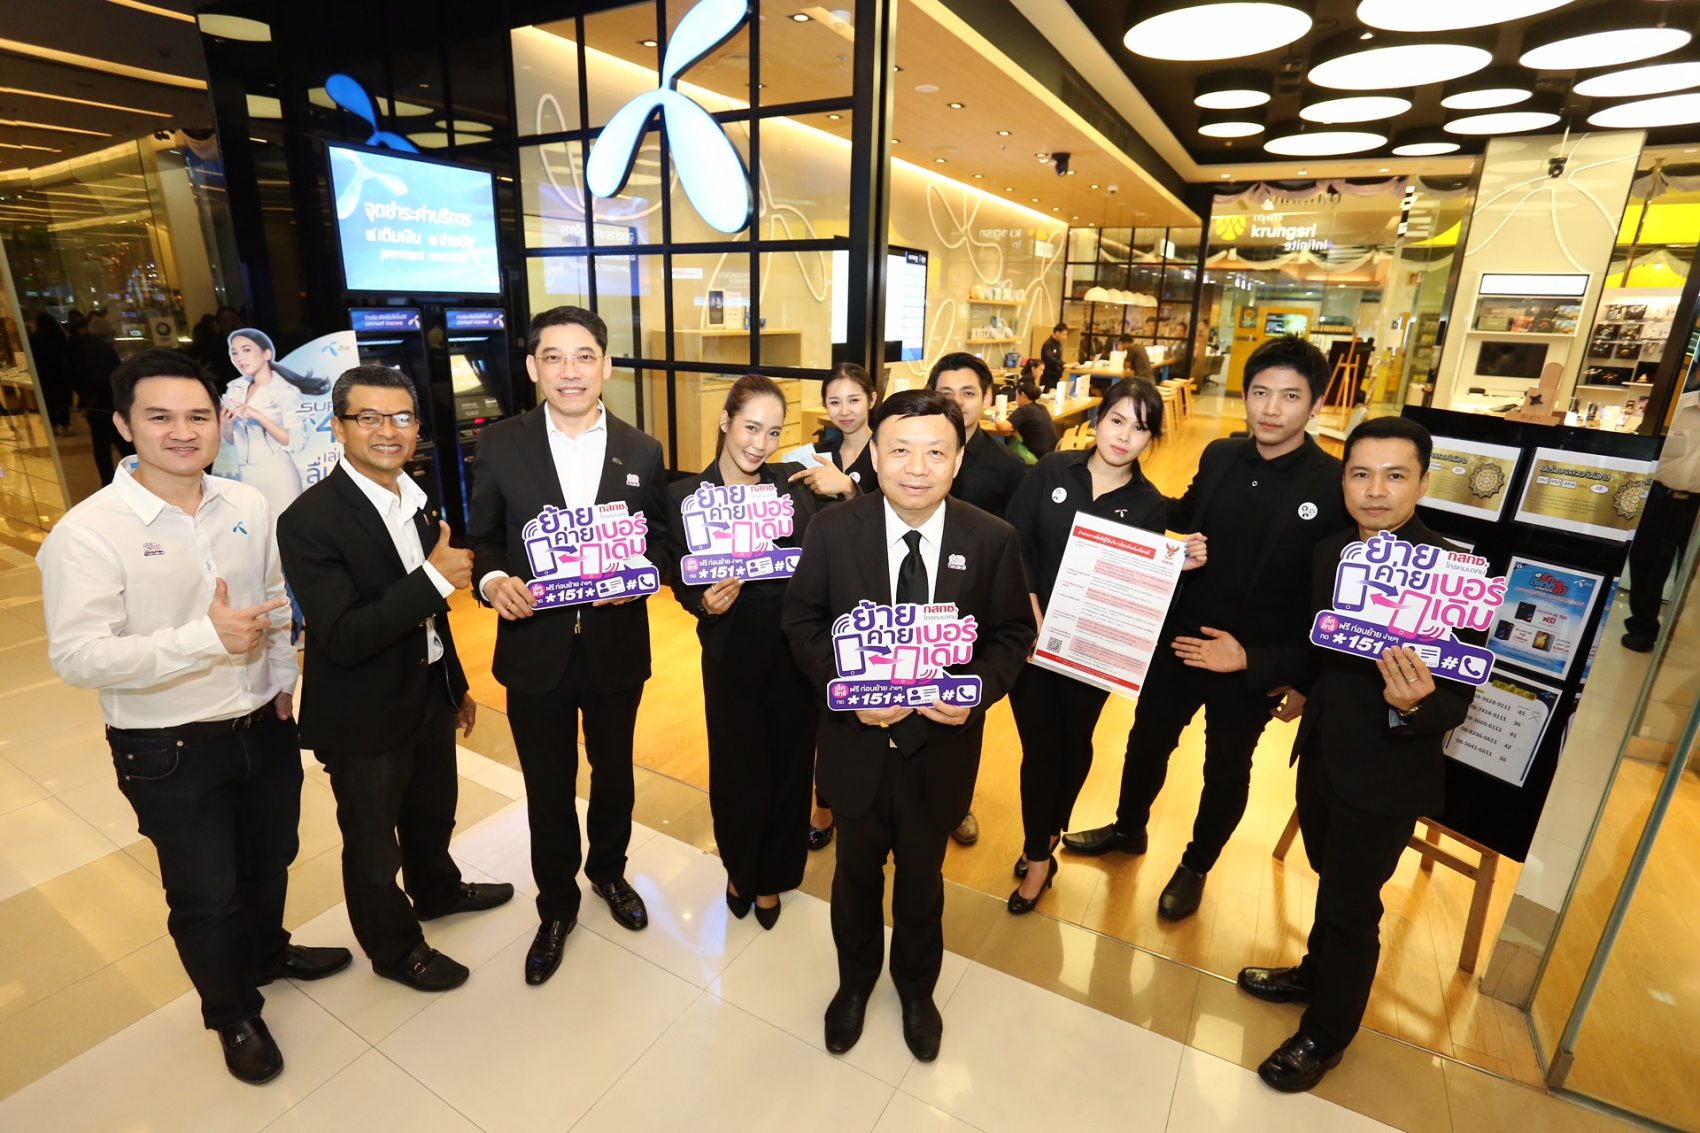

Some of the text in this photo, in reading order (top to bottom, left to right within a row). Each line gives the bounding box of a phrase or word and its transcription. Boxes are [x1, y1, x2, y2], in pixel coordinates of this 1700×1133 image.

[364, 201, 472, 227] จุดชำระค่าบริการ
[1251, 223, 1317, 240] krungsri
[696, 483, 745, 508] ย้าย
[710, 494, 794, 520] ค่าย เบอร์
[539, 507, 593, 533] ย้าย
[555, 513, 647, 545] ค่าย เบอร์
[755, 518, 793, 539] เดิม
[604, 537, 645, 559] เดิม
[1366, 532, 1439, 569] ย้าย
[1448, 551, 1488, 567] กสทช.
[1375, 561, 1430, 590] ค่าย
[1430, 573, 1506, 606] เบอร์
[852, 601, 915, 631] ย้าย
[923, 604, 958, 613] กสทช.
[1431, 598, 1494, 630] เดิม
[868, 616, 976, 644] ค่าย เบอร์
[1339, 622, 1400, 644] ฟรี ก่อนย้าย ง่ายๆ
[923, 643, 971, 666] เดิม
[860, 684, 887, 692] ก่อนย้าย
